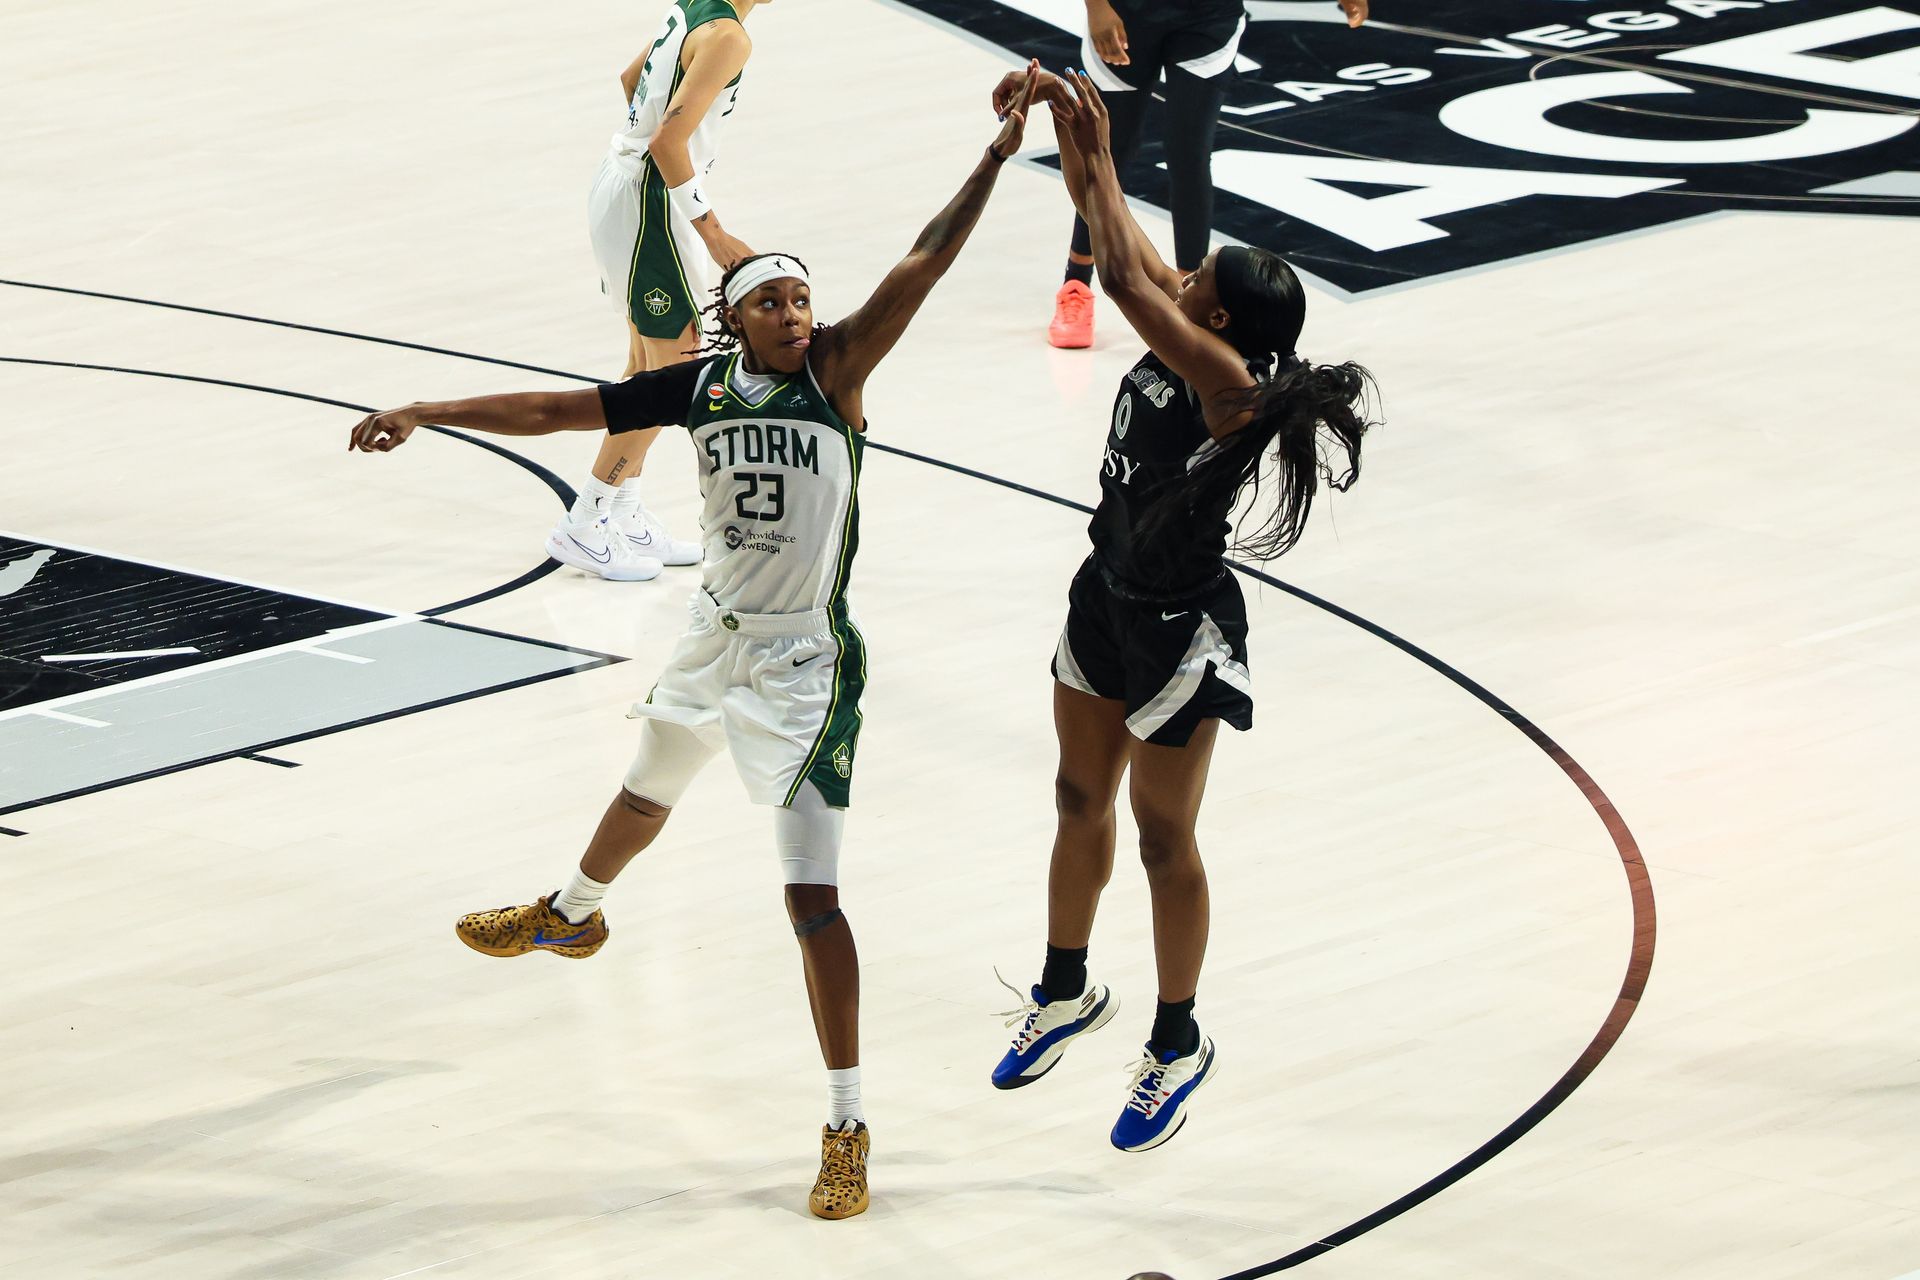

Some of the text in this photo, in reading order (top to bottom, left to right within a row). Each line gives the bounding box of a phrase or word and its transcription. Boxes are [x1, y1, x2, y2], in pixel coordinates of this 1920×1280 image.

[1220, 0, 1794, 116] LAS VEGA
[1115, 392, 1132, 440] 0
[705, 424, 819, 476] STORM
[733, 472, 785, 522] 23
[741, 542, 781, 554] SWEDISH
[745, 528, 797, 543] Providence
